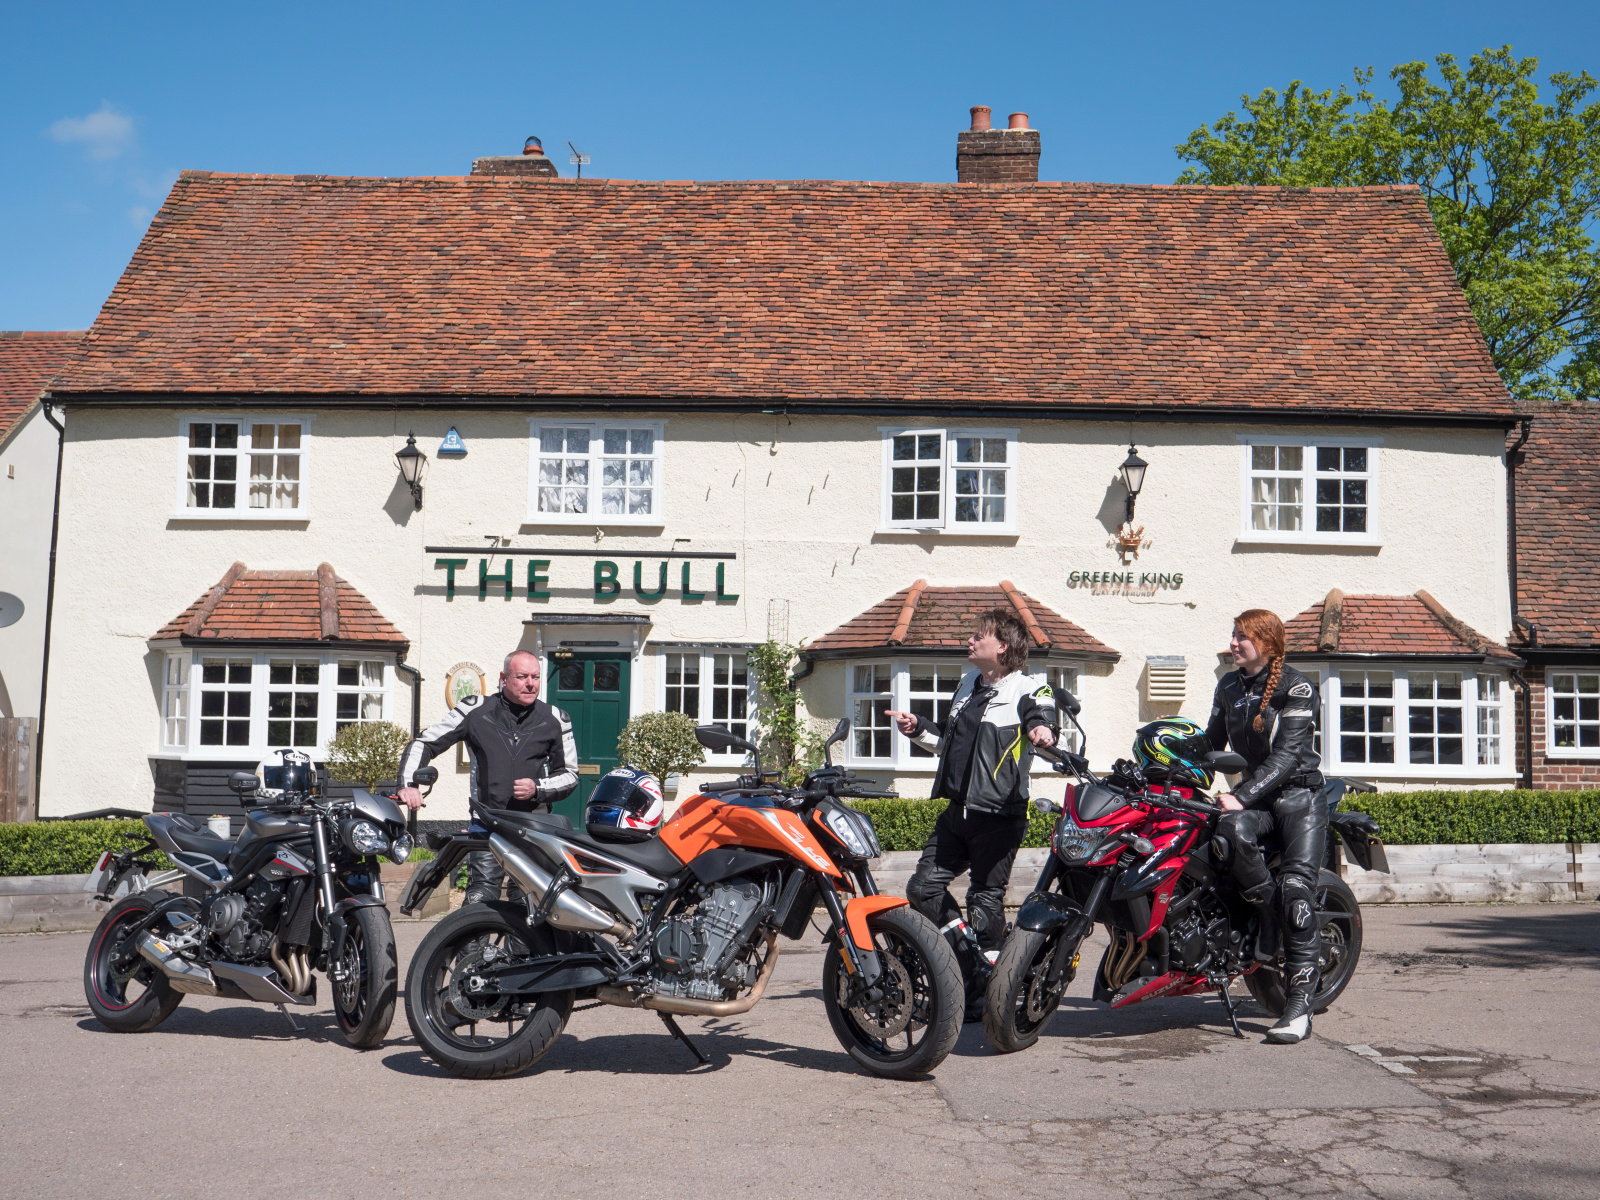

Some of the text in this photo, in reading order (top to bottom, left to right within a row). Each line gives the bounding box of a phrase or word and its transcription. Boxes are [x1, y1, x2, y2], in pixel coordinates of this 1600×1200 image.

[435, 558, 739, 600] THE BULL
[1069, 571, 1184, 584] GREENE KING
